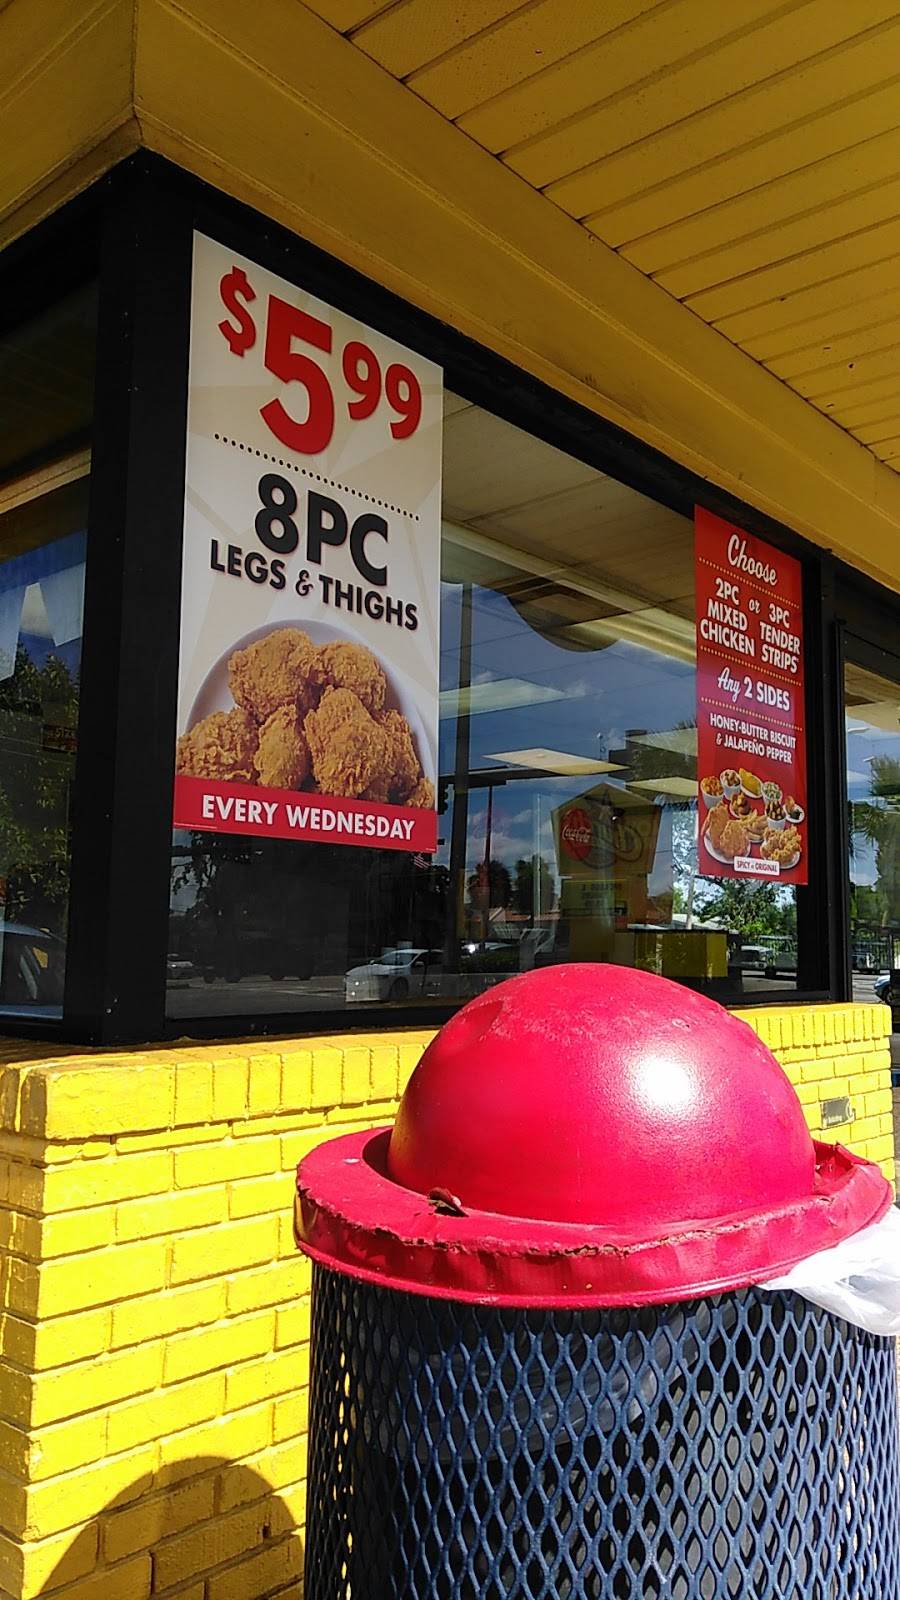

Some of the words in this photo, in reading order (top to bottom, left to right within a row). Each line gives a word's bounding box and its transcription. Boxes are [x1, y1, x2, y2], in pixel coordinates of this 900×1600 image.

[255, 473, 389, 586] 8PC
[210, 539, 286, 590] LEGS
[295, 570, 313, 596] &
[318, 573, 419, 631] THIGHS
[728, 534, 778, 586] Choose
[707, 598, 748, 632] MIXED
[759, 621, 800, 655] TENDER
[715, 577, 740, 606] 2PC
[748, 599, 760, 615] or
[769, 603, 790, 629] 3PC
[700, 619, 755, 657] CHICKEN
[761, 644, 798, 674] STRIPS
[717, 667, 741, 703] Any
[743, 676, 754, 699] 2
[756, 681, 790, 711] SIDES
[710, 713, 768, 741] HONEY-BUTTER
[770, 731, 796, 749] BISCUIT
[715, 732, 722, 745] &
[724, 734, 765, 756] JALAPEÑO
[766, 746, 792, 764] PEPPER
[202, 795, 278, 825] EVERY
[286, 804, 415, 840] WEDNESDAY
[736, 860, 750, 869] SPICY
[754, 862, 778, 873] ORIGINAL
